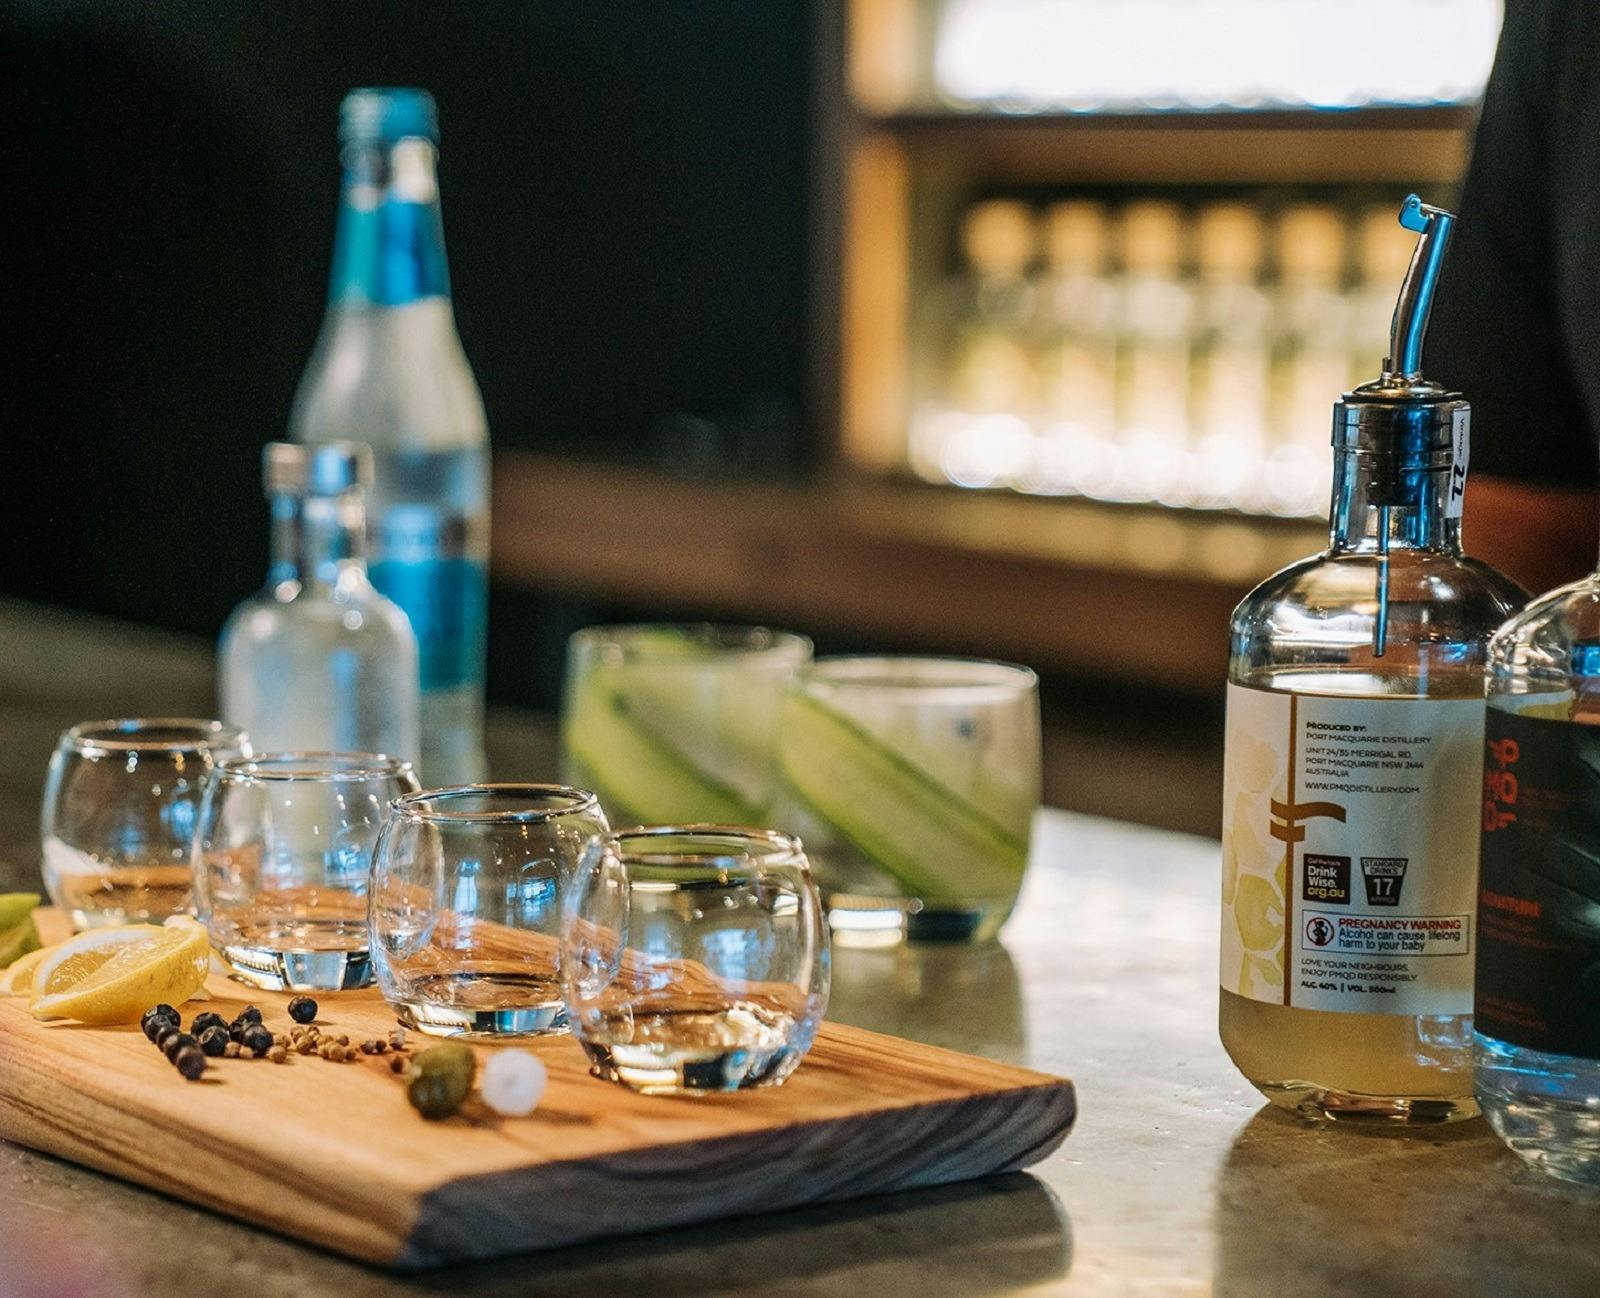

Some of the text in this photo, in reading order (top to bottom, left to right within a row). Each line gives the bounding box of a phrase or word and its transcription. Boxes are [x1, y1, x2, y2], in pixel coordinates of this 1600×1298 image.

[1306, 722, 1351, 731] PRODUCED
[1329, 734, 1380, 743] MACQUARIE
[1382, 736, 1432, 744] DISTILLERY
[1350, 750, 1396, 758] MERRIGAL
[1306, 757, 1327, 765] PORT
[1328, 759, 1380, 769] MACQUARIE
[1382, 761, 1403, 769] NSW
[1305, 768, 1349, 777] AUSTRALIA
[1364, 859, 1404, 868] STANDARD
[1307, 865, 1337, 878] Drink
[1370, 867, 1399, 875] DRINKS
[1373, 878, 1394, 896] 17
[1307, 887, 1345, 899] org.au
[1338, 918, 1461, 930] PREGNANCY WARNING
[1338, 928, 1460, 942] Alcohol can cause lifelong
[1338, 939, 1425, 952] harm to your baby
[1301, 957, 1322, 967] LOVE
[1323, 959, 1347, 969] YOUR
[1301, 968, 1327, 977] ENJOY
[1319, 982, 1338, 991] 40%
